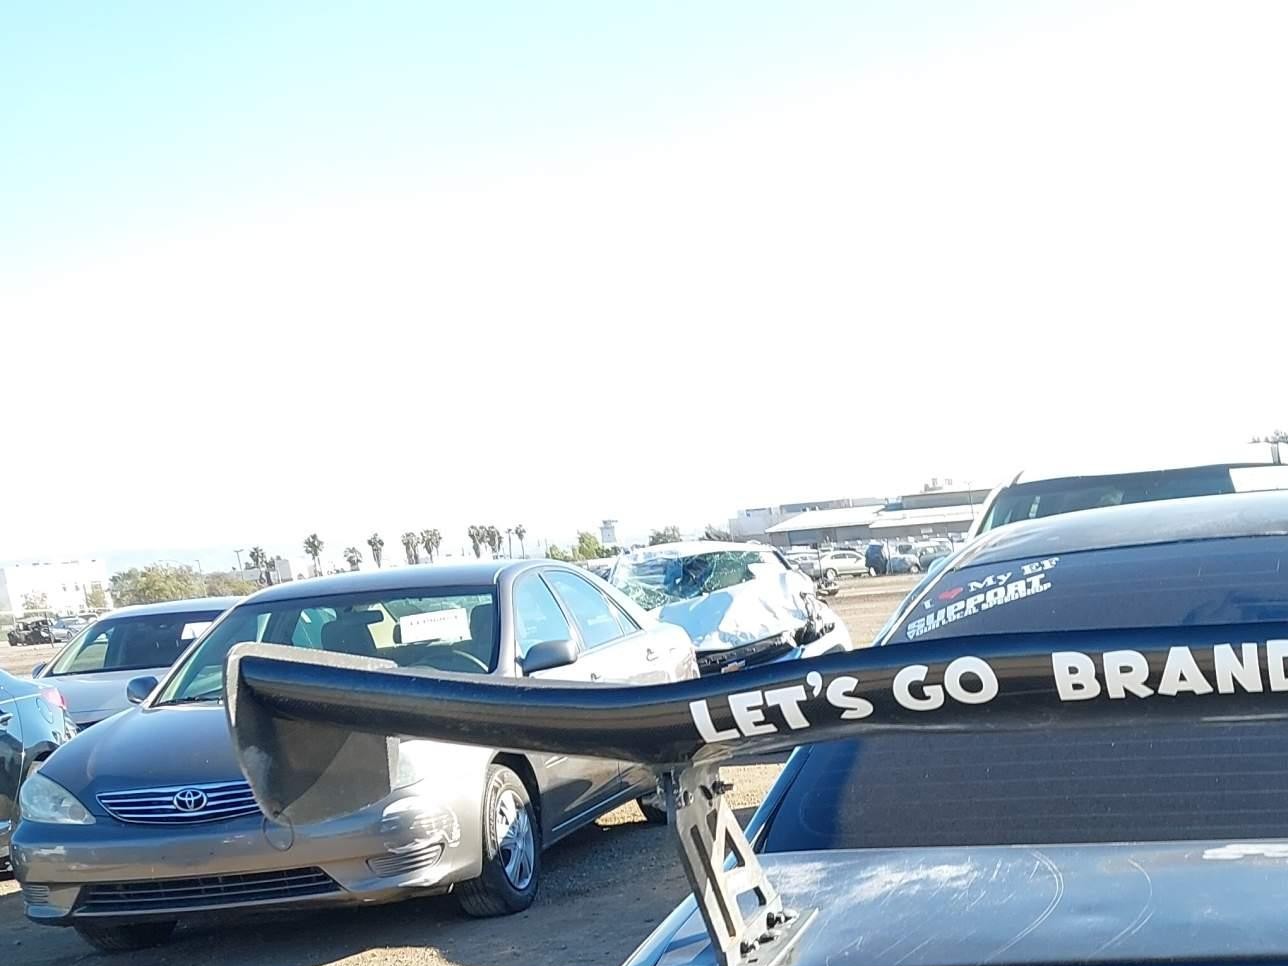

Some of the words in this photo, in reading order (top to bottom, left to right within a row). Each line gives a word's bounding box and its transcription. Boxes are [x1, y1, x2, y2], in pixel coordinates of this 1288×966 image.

[907, 573, 1046, 632] SUPPORT
[967, 572, 1013, 592] My
[689, 671, 874, 744] LET'S
[892, 655, 999, 711] GO
